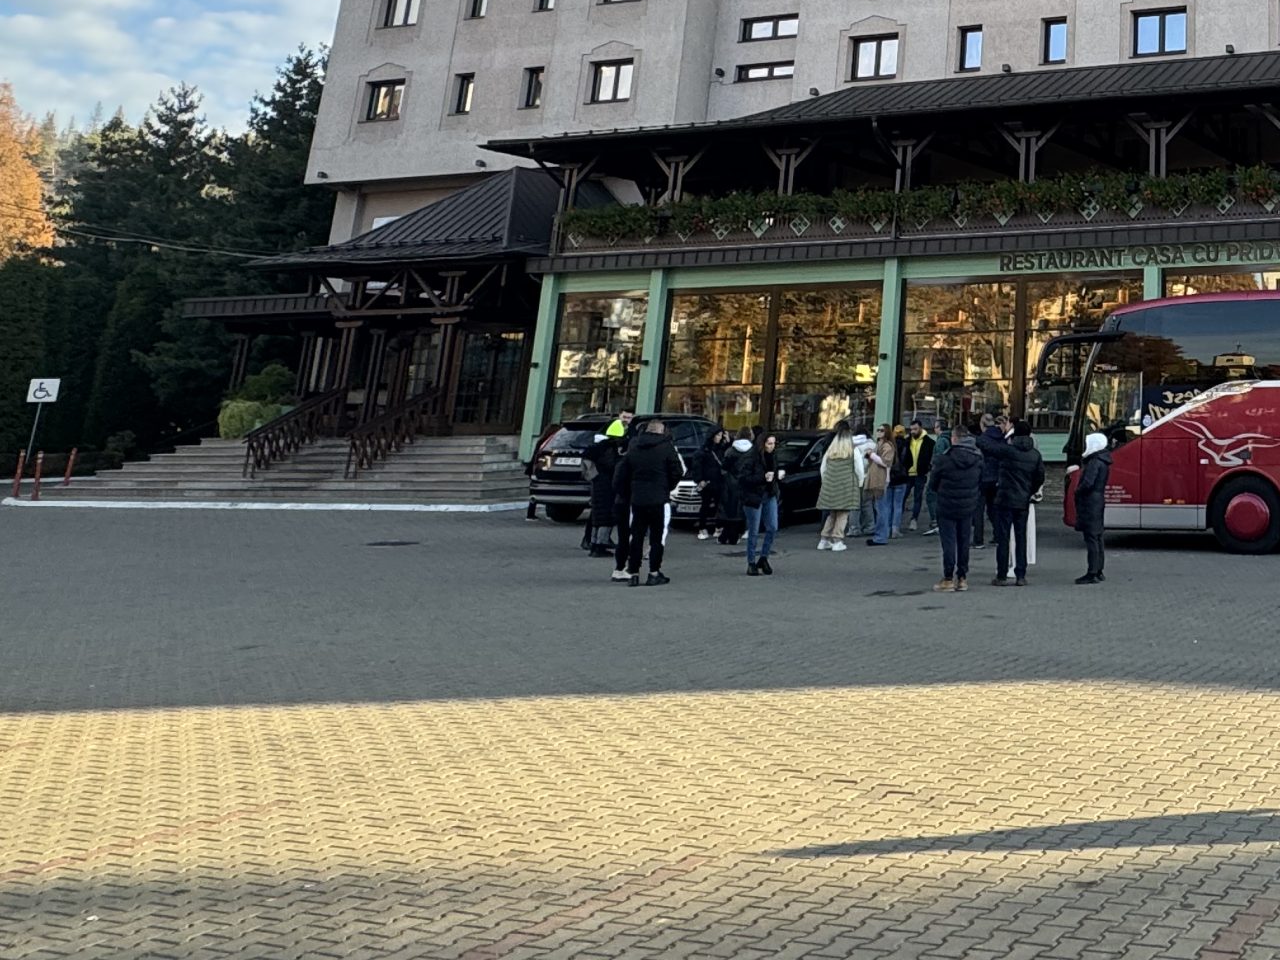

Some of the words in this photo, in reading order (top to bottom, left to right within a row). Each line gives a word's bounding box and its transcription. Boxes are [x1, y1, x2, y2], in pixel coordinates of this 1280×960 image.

[1000, 247, 1126, 271] RESTAURANT
[1131, 244, 1185, 265] CASA
[1192, 243, 1219, 262] CU
